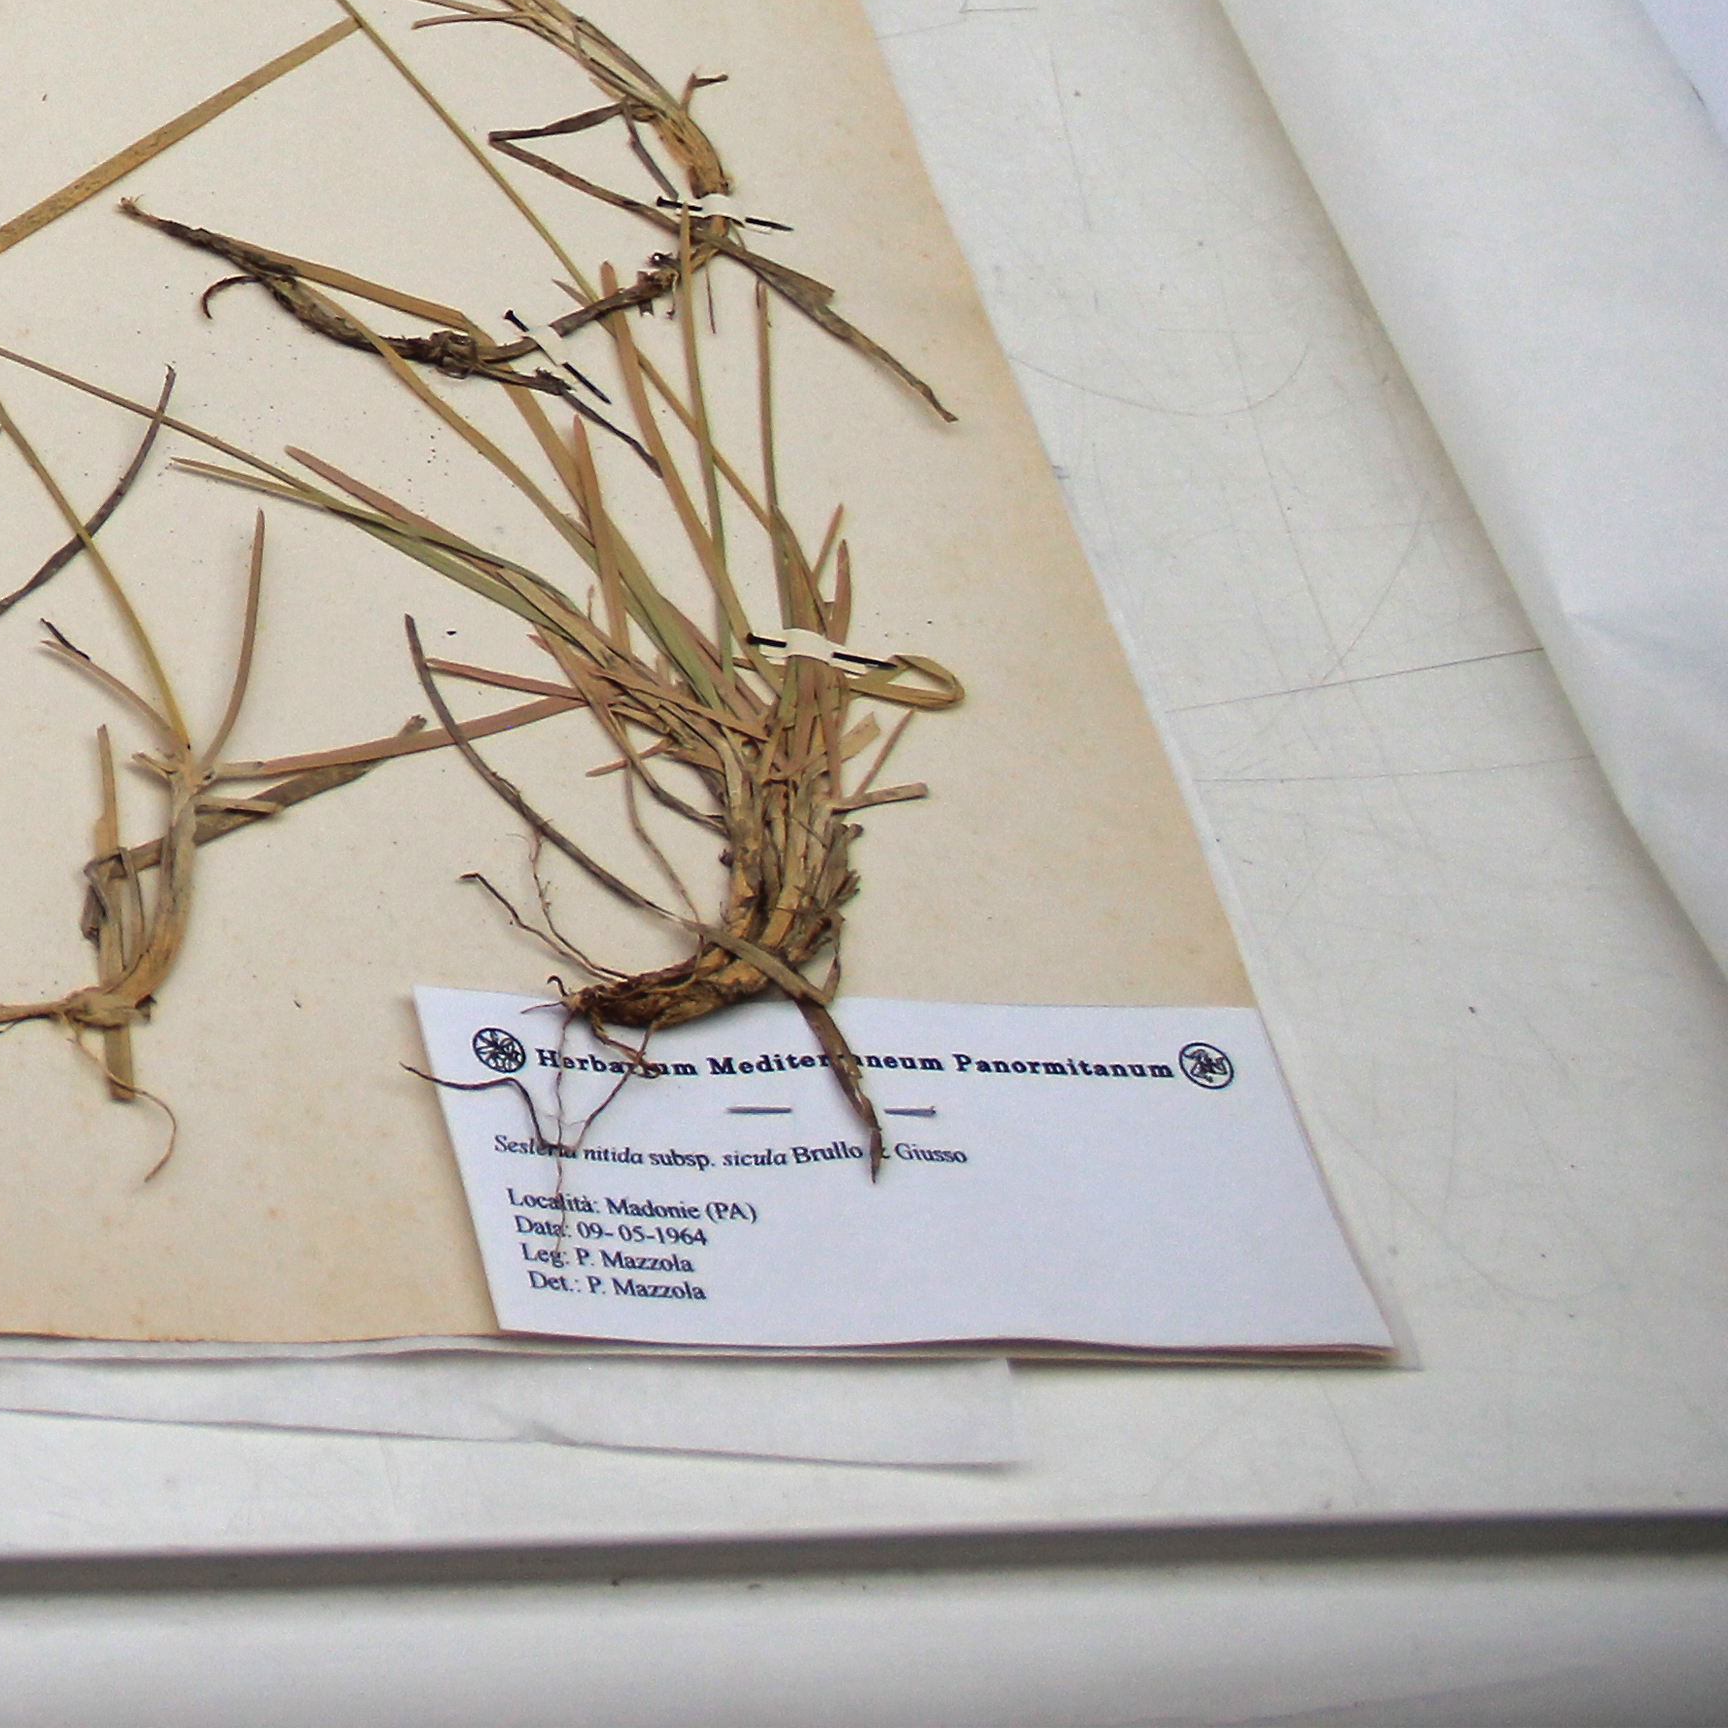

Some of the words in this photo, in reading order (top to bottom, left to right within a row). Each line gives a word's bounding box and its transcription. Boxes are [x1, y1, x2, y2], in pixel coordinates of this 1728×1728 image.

[952, 1053, 1175, 1078] Panormitanum
[583, 1145, 643, 1165] nitida
[648, 1149, 716, 1171] subsp.
[722, 1148, 788, 1166] sicula
[792, 1141, 863, 1165] Brullo
[895, 1143, 968, 1164] Giusso
[506, 1187, 600, 1214] Località:
[604, 1196, 701, 1220] Madonie
[705, 1202, 757, 1223] (PA)
[514, 1214, 572, 1238] Data:
[576, 1248, 595, 1266] P.
[603, 1250, 695, 1273] Mazzola
[528, 1271, 582, 1293] Det.:
[588, 1275, 606, 1294] P.
[613, 1278, 707, 1301] Mazzola
